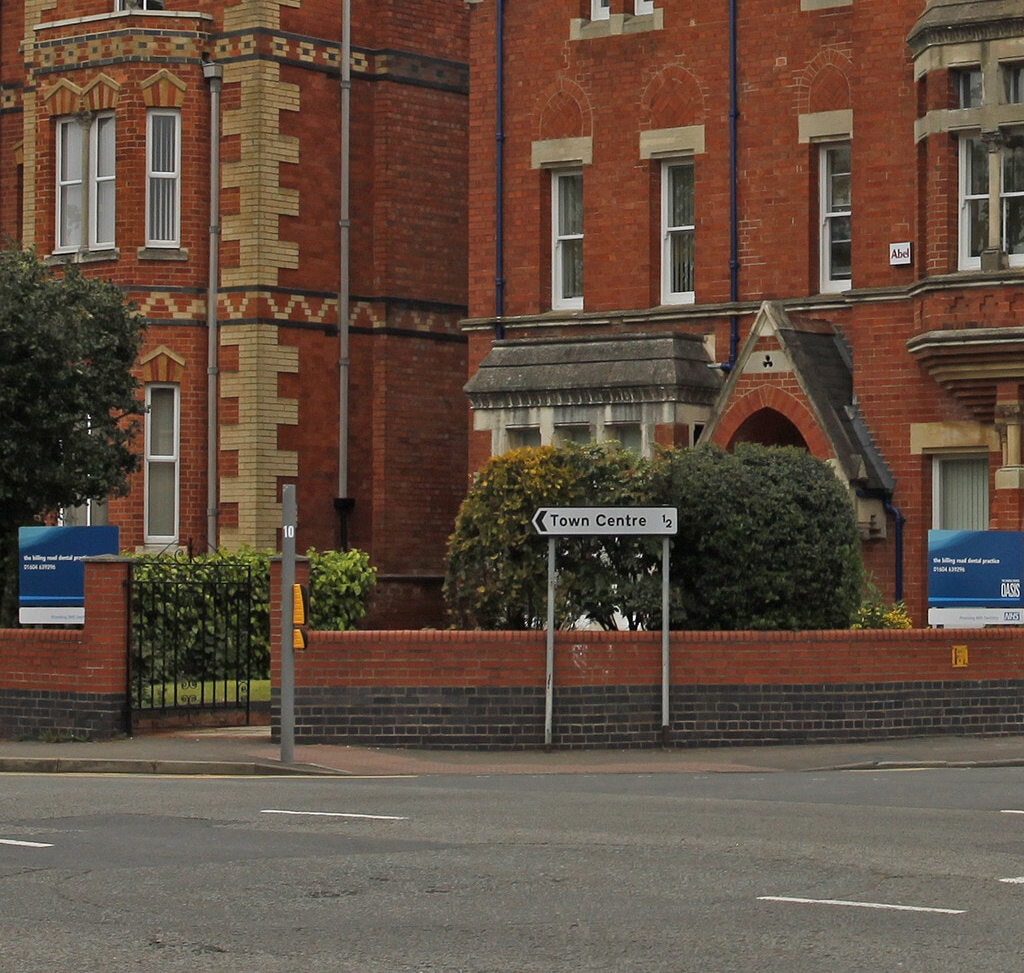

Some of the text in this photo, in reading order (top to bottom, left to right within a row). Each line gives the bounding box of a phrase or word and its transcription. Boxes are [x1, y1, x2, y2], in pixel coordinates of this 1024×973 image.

[891, 248, 910, 259] Abel
[550, 514, 590, 527] Town
[595, 514, 647, 527] Centre
[283, 525, 295, 538] 10
[942, 557, 956, 565] billing
[1001, 583, 1020, 598] OASIS
[1004, 612, 1020, 621] NHS
